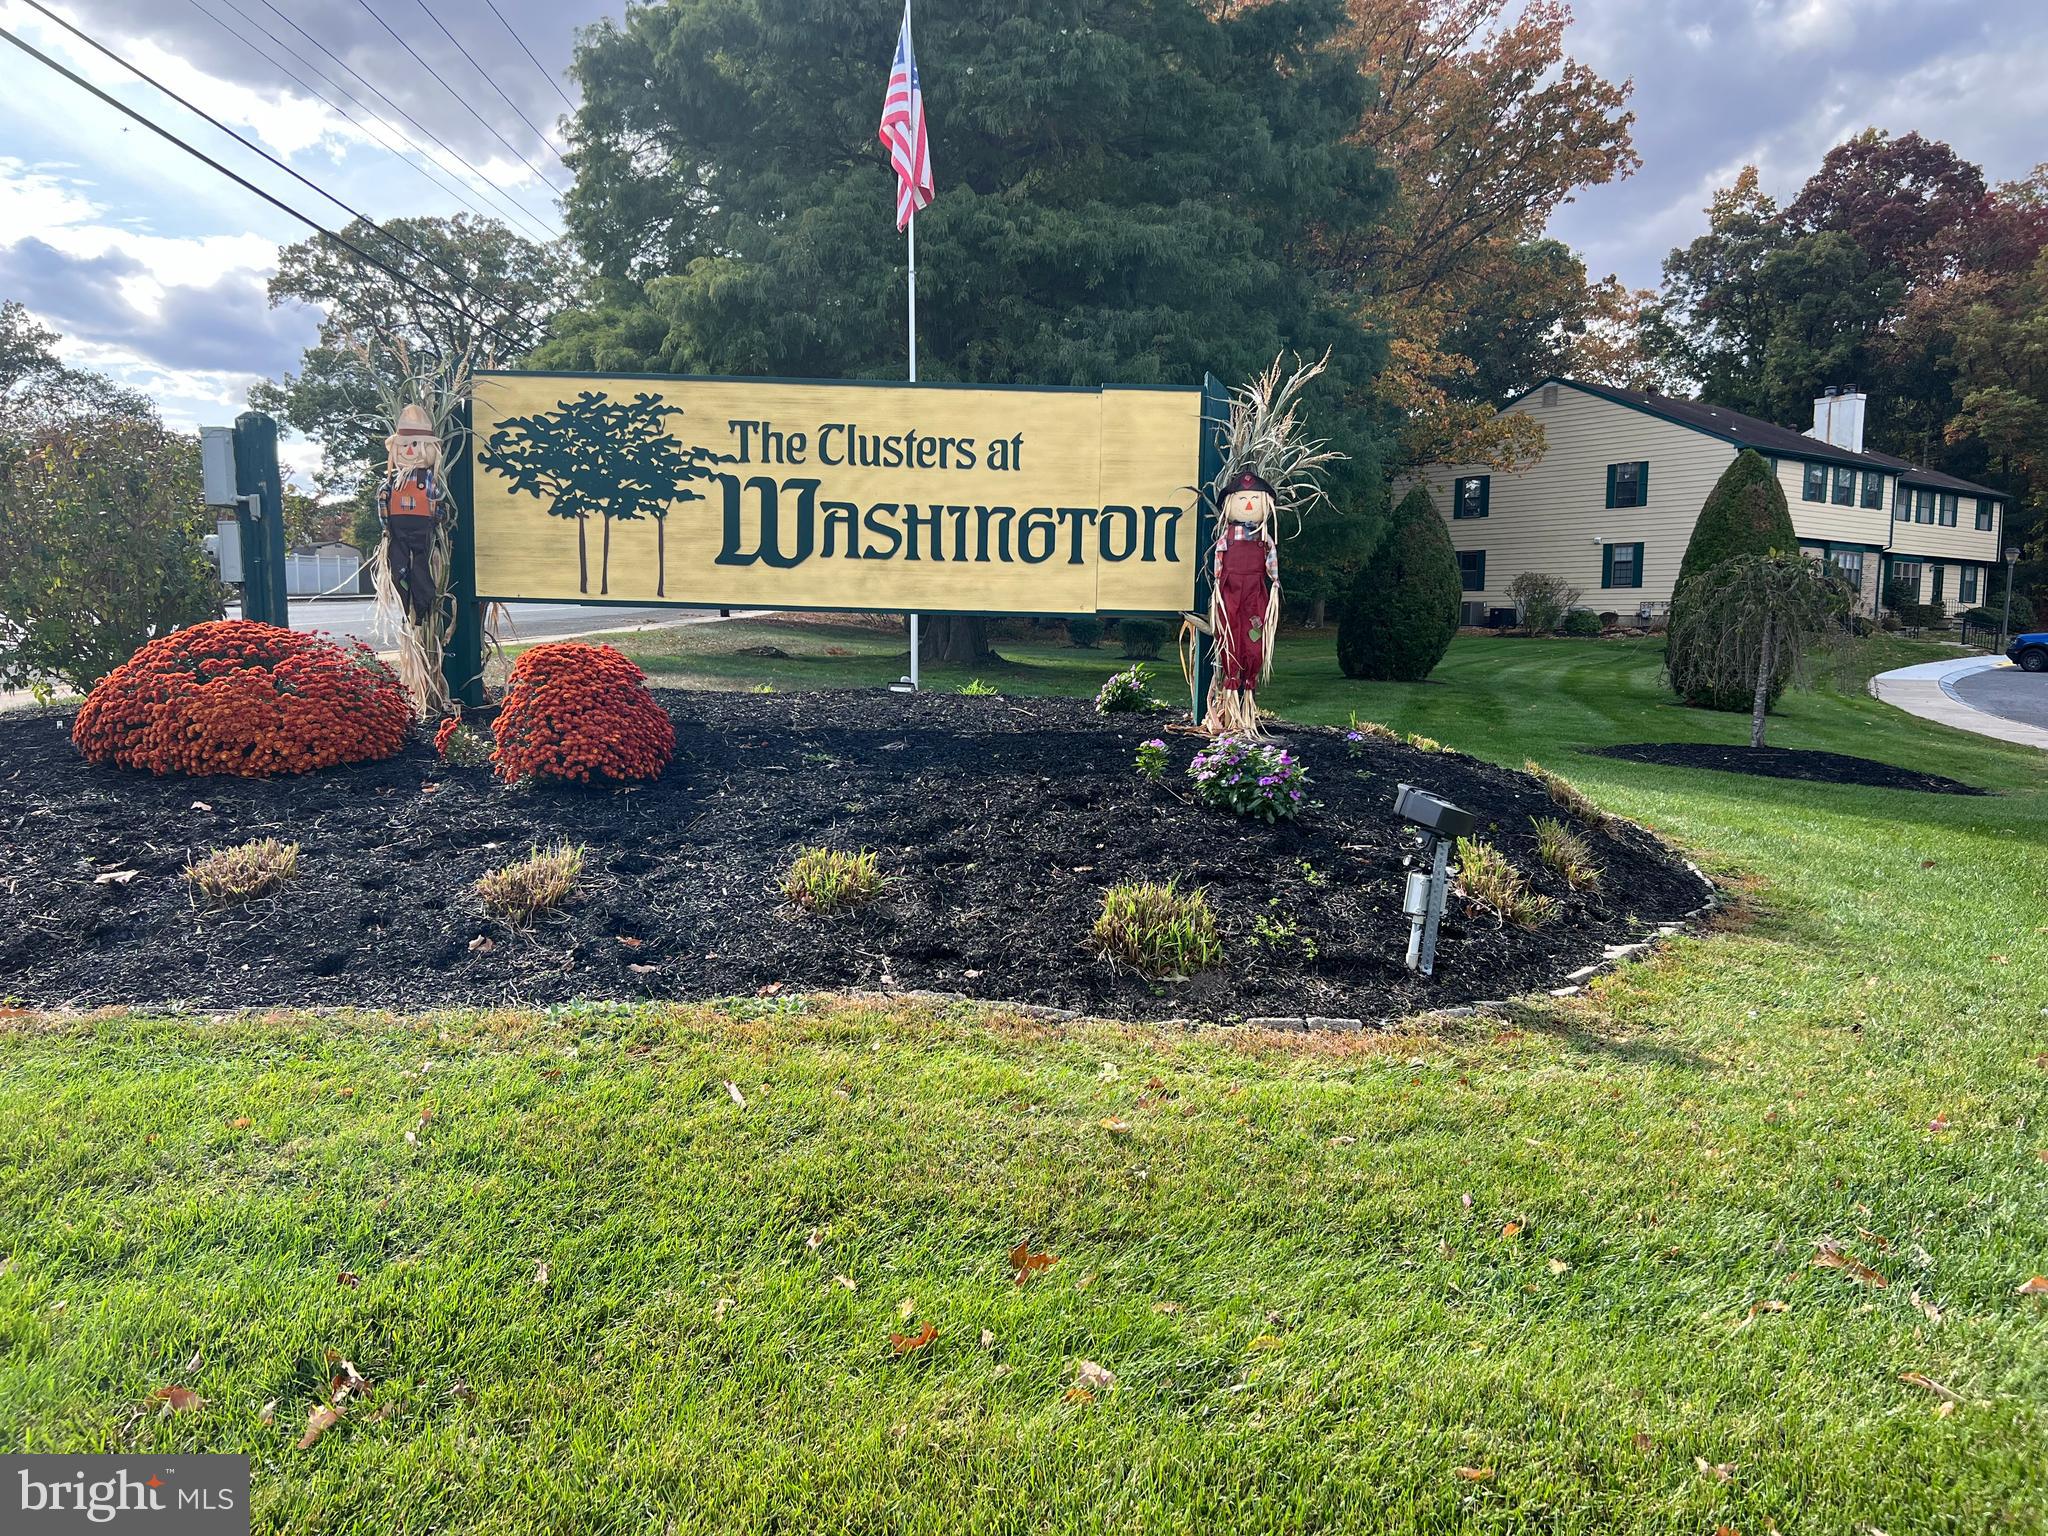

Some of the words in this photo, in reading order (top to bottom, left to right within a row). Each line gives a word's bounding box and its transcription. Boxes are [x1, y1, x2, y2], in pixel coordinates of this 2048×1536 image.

[728, 419, 807, 465] The
[817, 422, 977, 470] Clusters
[986, 430, 1024, 473] at
[714, 475, 1183, 569] WASHINGTON
